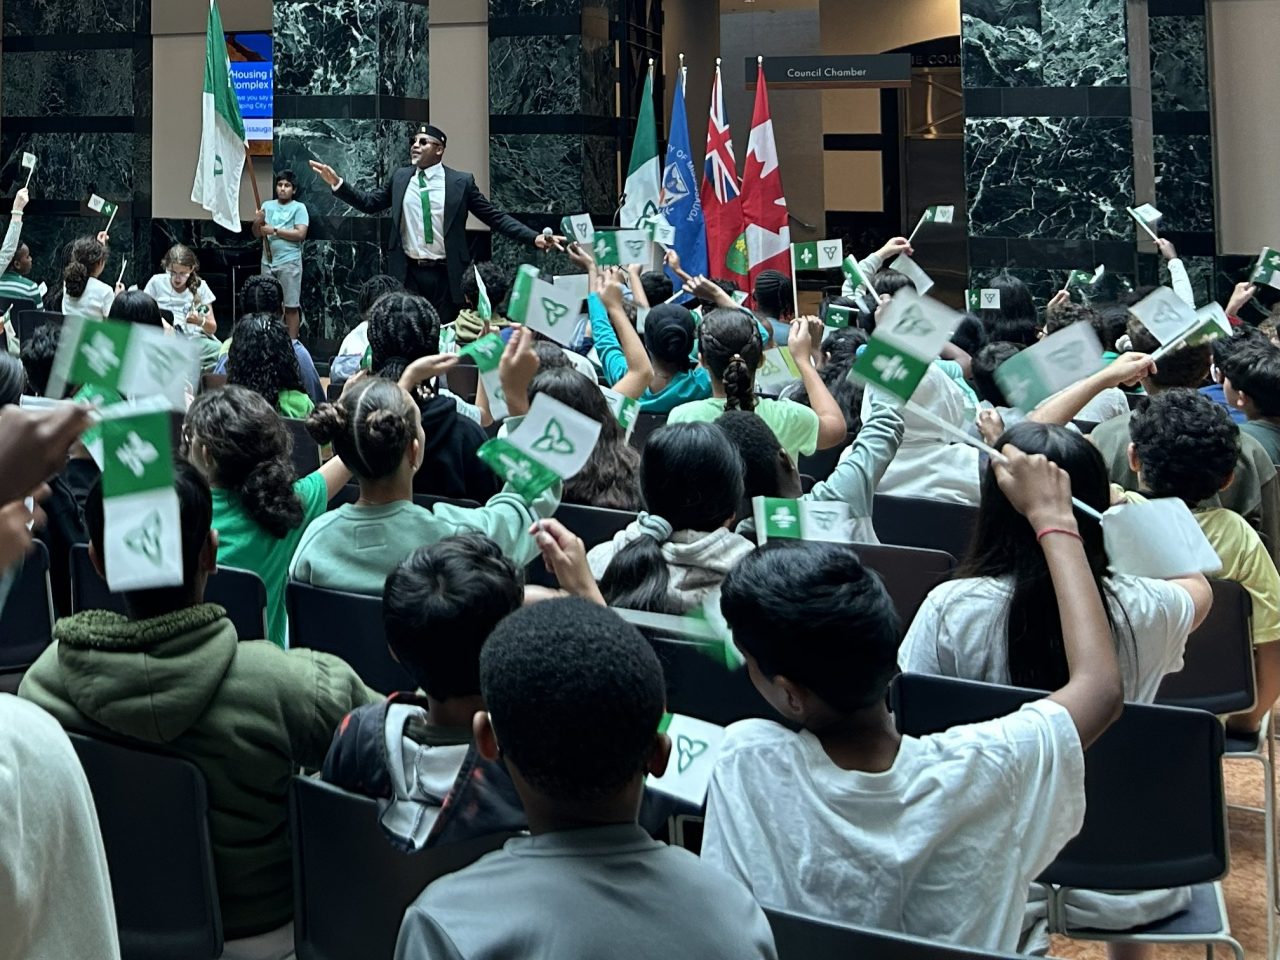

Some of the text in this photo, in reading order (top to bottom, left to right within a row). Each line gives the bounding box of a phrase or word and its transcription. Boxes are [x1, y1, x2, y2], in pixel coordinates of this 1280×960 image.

[233, 69, 267, 80] Housing
[787, 66, 867, 78] Council Chamber
[676, 149, 688, 160] OF
